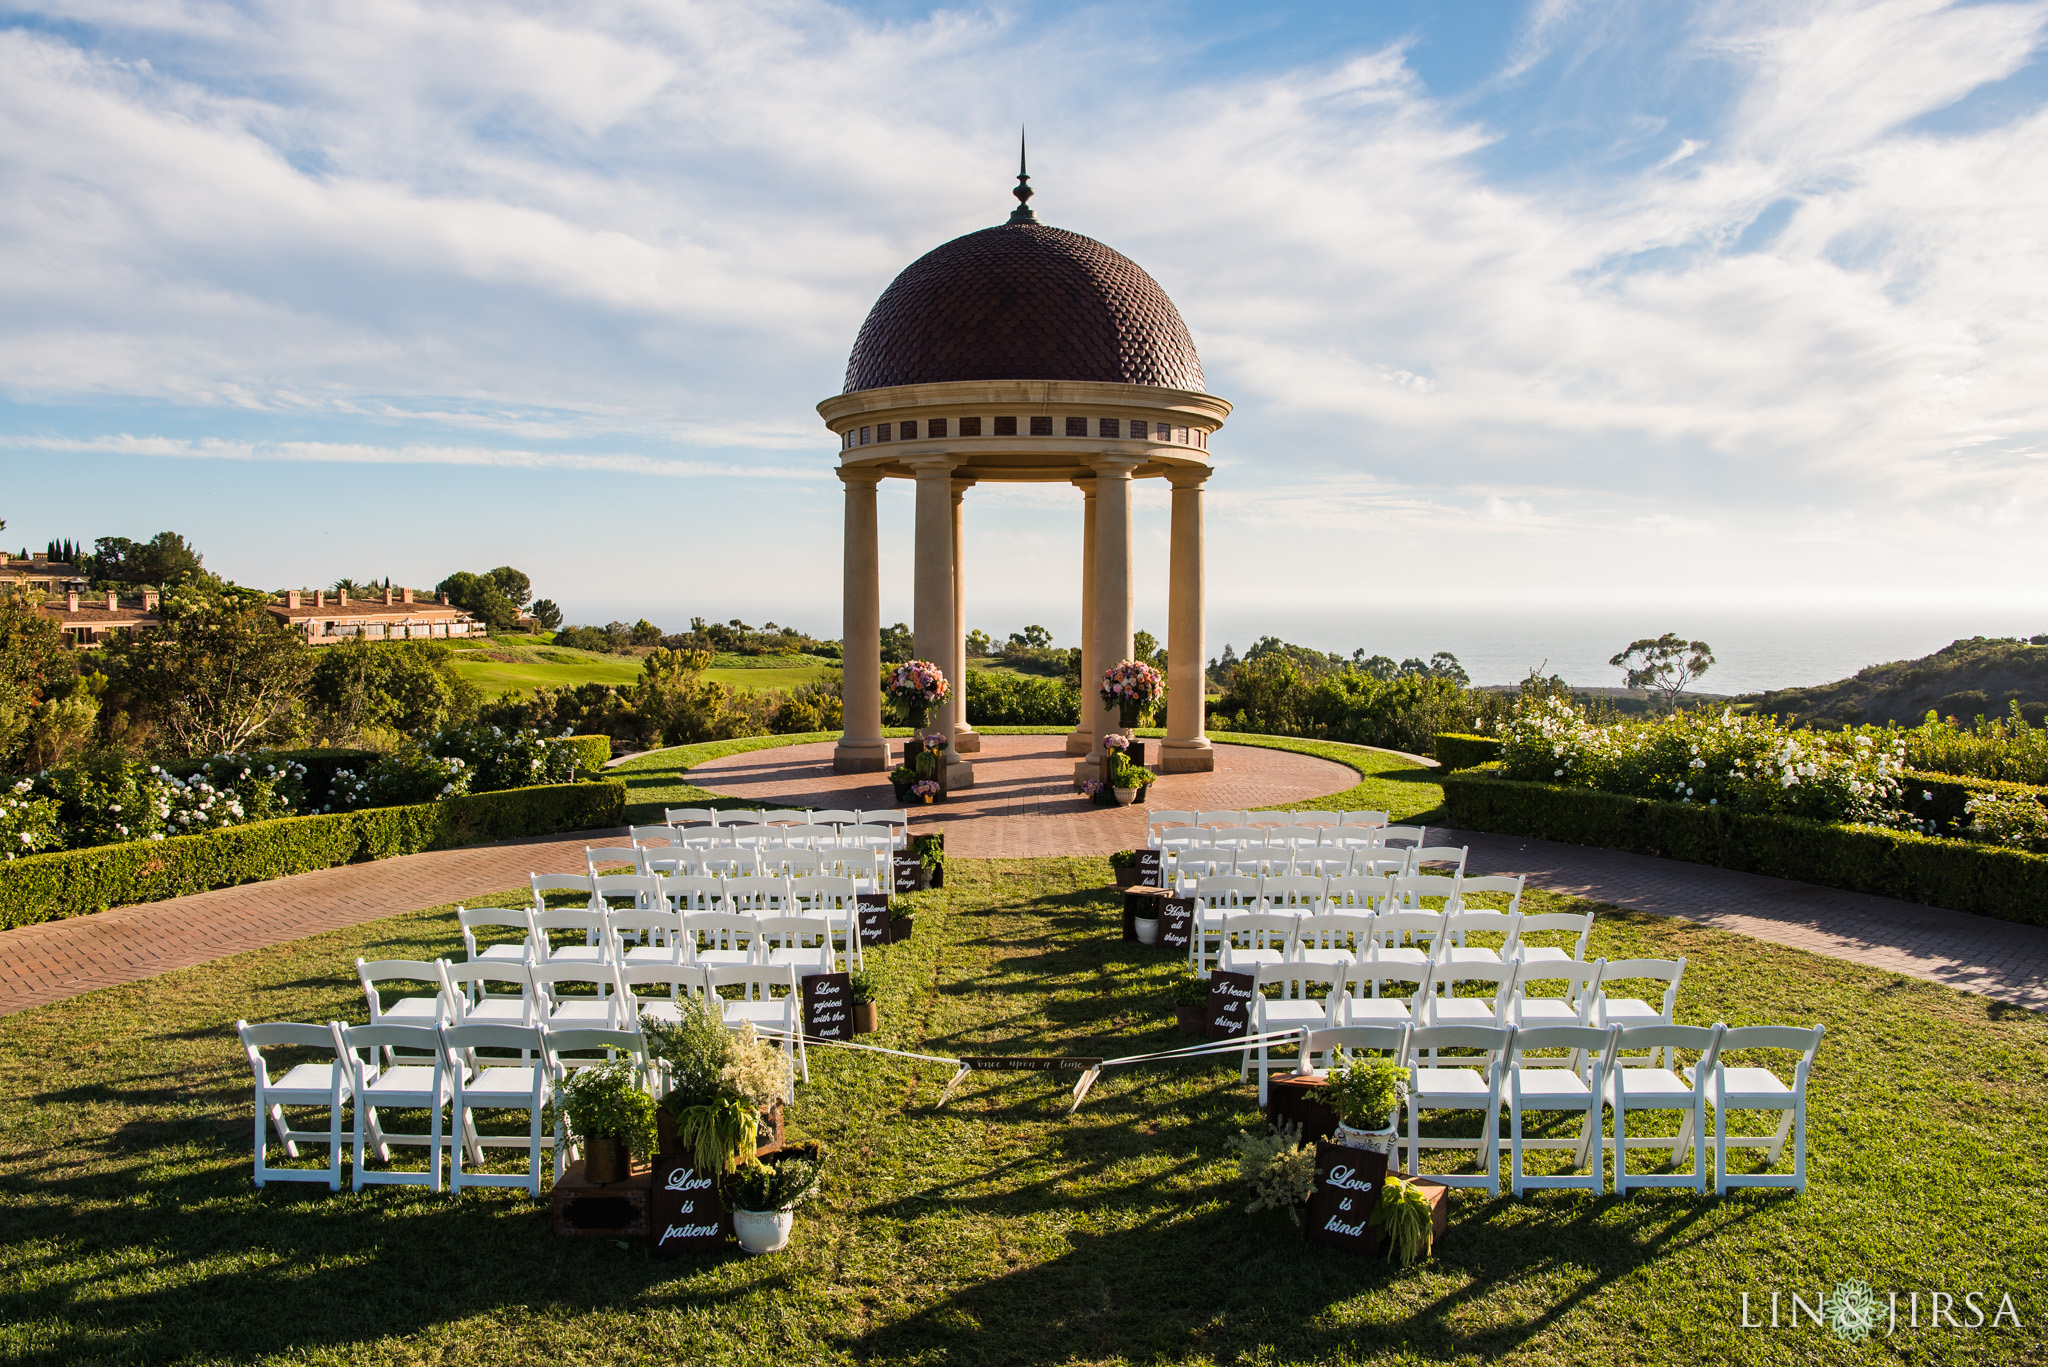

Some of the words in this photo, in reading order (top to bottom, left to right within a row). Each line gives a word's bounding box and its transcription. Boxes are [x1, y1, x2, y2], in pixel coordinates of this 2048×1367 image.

[893, 856, 920, 866] Endures
[1141, 854, 1159, 865] Love
[901, 867, 911, 875] all
[896, 878, 916, 889] things
[1141, 877, 1155, 886] fails
[857, 902, 887, 913] Believes
[1164, 904, 1191, 920] Hopes
[865, 915, 877, 924] all
[1171, 920, 1183, 929] all
[860, 927, 882, 940] things
[1164, 932, 1188, 947] things
[815, 981, 840, 995] Love
[1227, 984, 1252, 998] bears
[813, 999, 842, 1014] rejoices
[1223, 1001, 1239, 1012] all
[812, 1012, 831, 1023] with
[832, 1011, 846, 1021] the
[819, 1025, 840, 1037] truth
[1214, 1015, 1243, 1034] things
[976, 1060, 1001, 1068] once
[1009, 1060, 1035, 1070] upon
[1043, 1061, 1051, 1069] a
[1058, 1059, 1085, 1069] time
[664, 1167, 712, 1191] Love
[1325, 1164, 1372, 1192] Love
[681, 1200, 694, 1214] is
[1338, 1197, 1353, 1211] is
[1324, 1214, 1366, 1237] kind
[658, 1222, 719, 1246] patient
